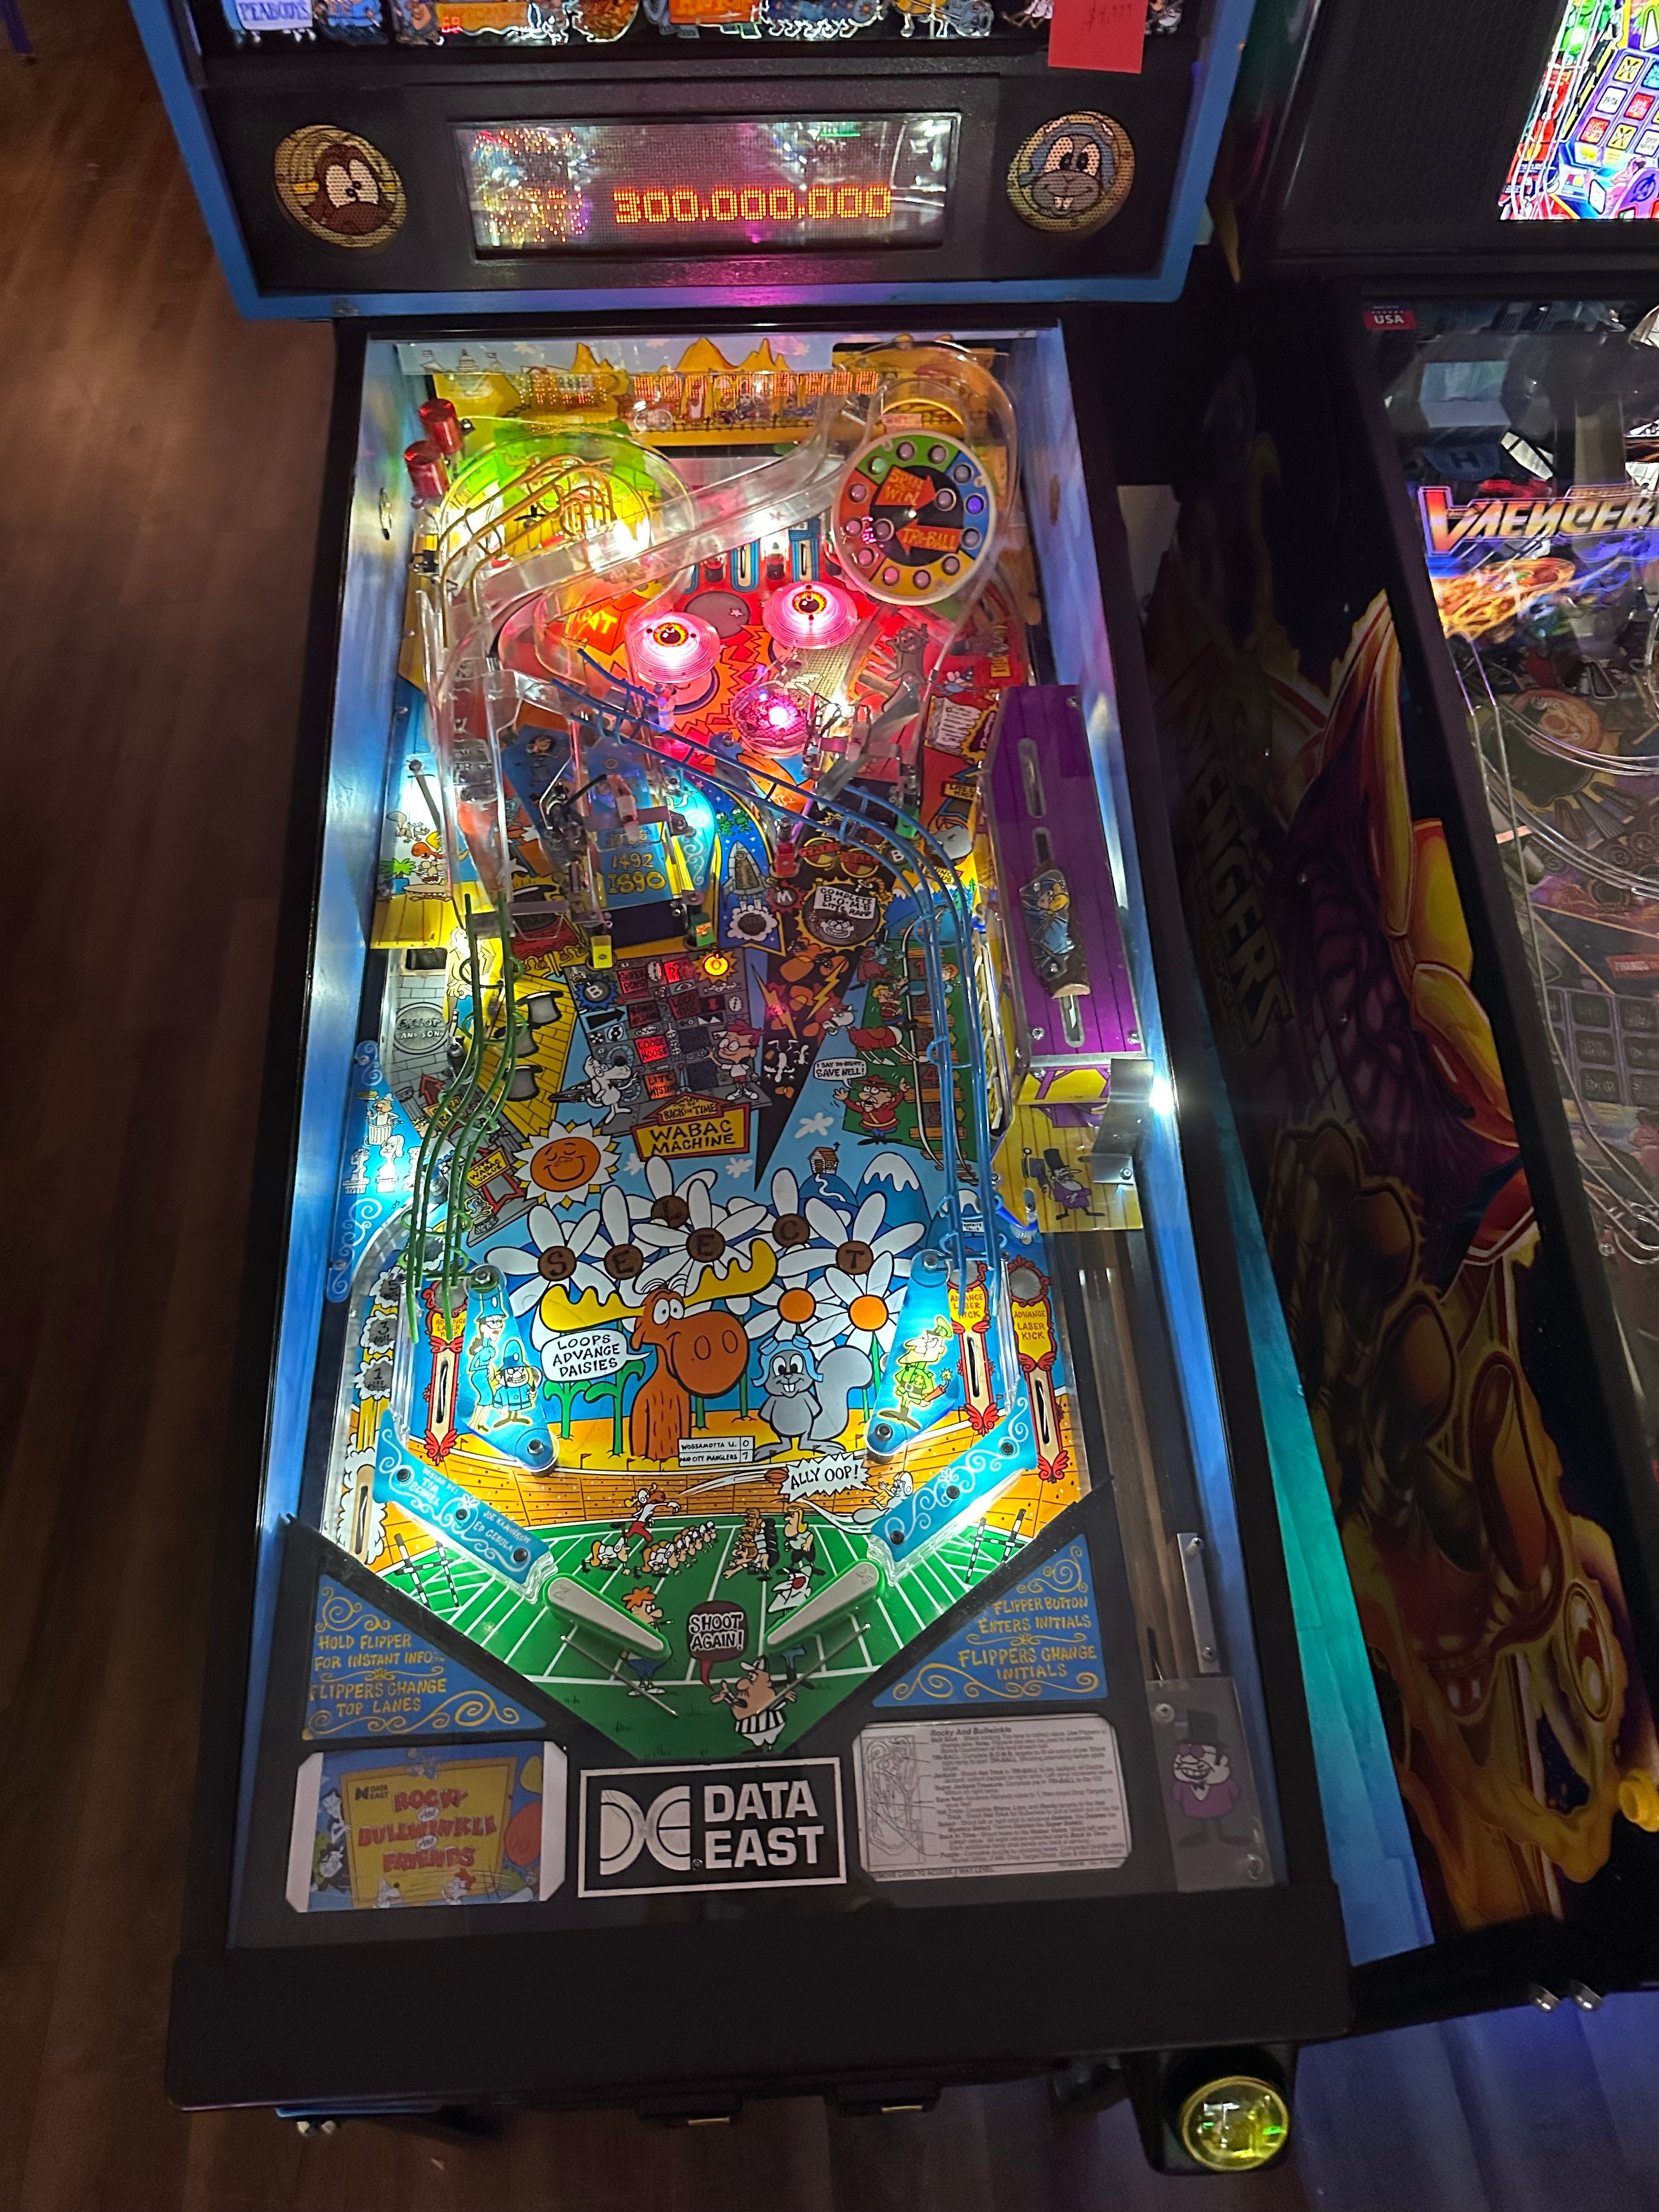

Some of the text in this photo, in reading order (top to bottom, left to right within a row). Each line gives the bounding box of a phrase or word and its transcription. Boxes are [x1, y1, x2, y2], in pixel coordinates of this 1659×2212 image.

[613, 185, 892, 223] 300,000,000
[1374, 314, 1404, 324] USA
[890, 471, 923, 486] SPIN
[885, 489, 921, 505] WIN
[612, 851, 654, 871] 1492
[891, 850, 905, 862] B
[777, 890, 793, 903] M
[820, 887, 873, 904] COMPLETE
[849, 909, 872, 917] RAMP
[916, 961, 926, 976] 1
[586, 985, 603, 998] B
[917, 996, 931, 1011] 2
[421, 1030, 441, 1039] SON
[642, 1047, 668, 1059] MOOSE
[816, 1067, 865, 1077] SAVE NELL!
[923, 1067, 939, 1085] 4
[663, 1107, 685, 1119] BACK
[693, 1103, 716, 1115] TIME
[650, 1120, 732, 1142] WABAC
[651, 1133, 736, 1156] MACHINE
[549, 1251, 566, 1276] S
[614, 1250, 635, 1276] E
[696, 1233, 714, 1258] E
[779, 1220, 800, 1242] C
[845, 1249, 865, 1269] T
[950, 1293, 984, 1302] ADANCE
[435, 1318, 466, 1326] ADNCE
[1014, 1310, 1046, 1319] ADVANCE
[378, 1321, 390, 1335] 3
[1017, 1322, 1046, 1331] LASER
[557, 1334, 612, 1351] LOOPS
[1021, 1331, 1045, 1340] KICK
[552, 1345, 621, 1367] ADVANCE
[558, 1358, 619, 1377] DAISIES
[681, 1442, 725, 1451] WOSSAMOTTA
[742, 1451, 748, 1460] 7
[422, 1476, 441, 1494] TIM
[790, 1464, 860, 1490] ALLY OOP!
[483, 1510, 495, 1522] JOE
[473, 1521, 484, 1532] ED
[992, 1596, 1088, 1615] FLIPPER BUTTON
[688, 1613, 744, 1633] SHOOT
[978, 1615, 1092, 1634] ENTERS INITIALS
[318, 1633, 411, 1650] HOLD FLIPPER
[690, 1631, 744, 1650] AGAIN!
[314, 1655, 342, 1671] FOR
[348, 1652, 400, 1668] INSTANT
[957, 1645, 1097, 1668] FLIPPERS CHANGE
[996, 1663, 1068, 1681] INITIALS
[308, 1678, 447, 1701] FLIPPERS CHANGE
[336, 1698, 422, 1716] TOP LANES
[370, 1785, 388, 1793] DATA
[370, 1792, 388, 1800] EAST
[392, 1787, 469, 1812] ROCKY
[704, 1779, 819, 1822] DATA
[357, 1814, 496, 1847] BULLWINKLE
[705, 1825, 825, 1869] EAST
[383, 1845, 476, 1873] FRIENDS
